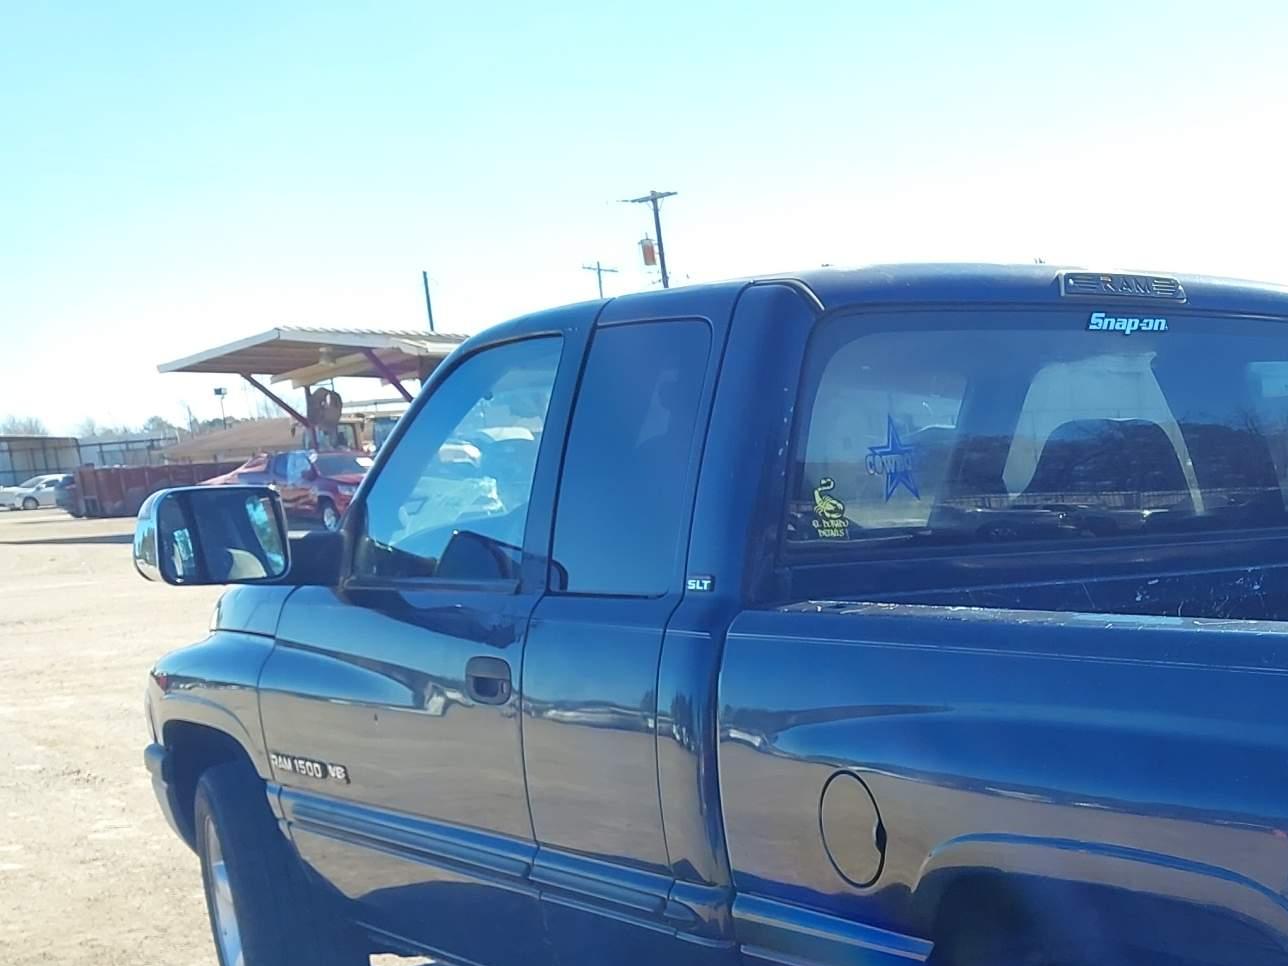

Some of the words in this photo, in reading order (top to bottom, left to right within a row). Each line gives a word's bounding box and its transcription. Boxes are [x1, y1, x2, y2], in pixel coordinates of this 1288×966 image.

[1100, 275, 1151, 295] RAM
[1089, 312, 1166, 335] Snap-on
[687, 580, 712, 591] SLT
[270, 753, 292, 771] RAM
[293, 758, 322, 778] 1500
